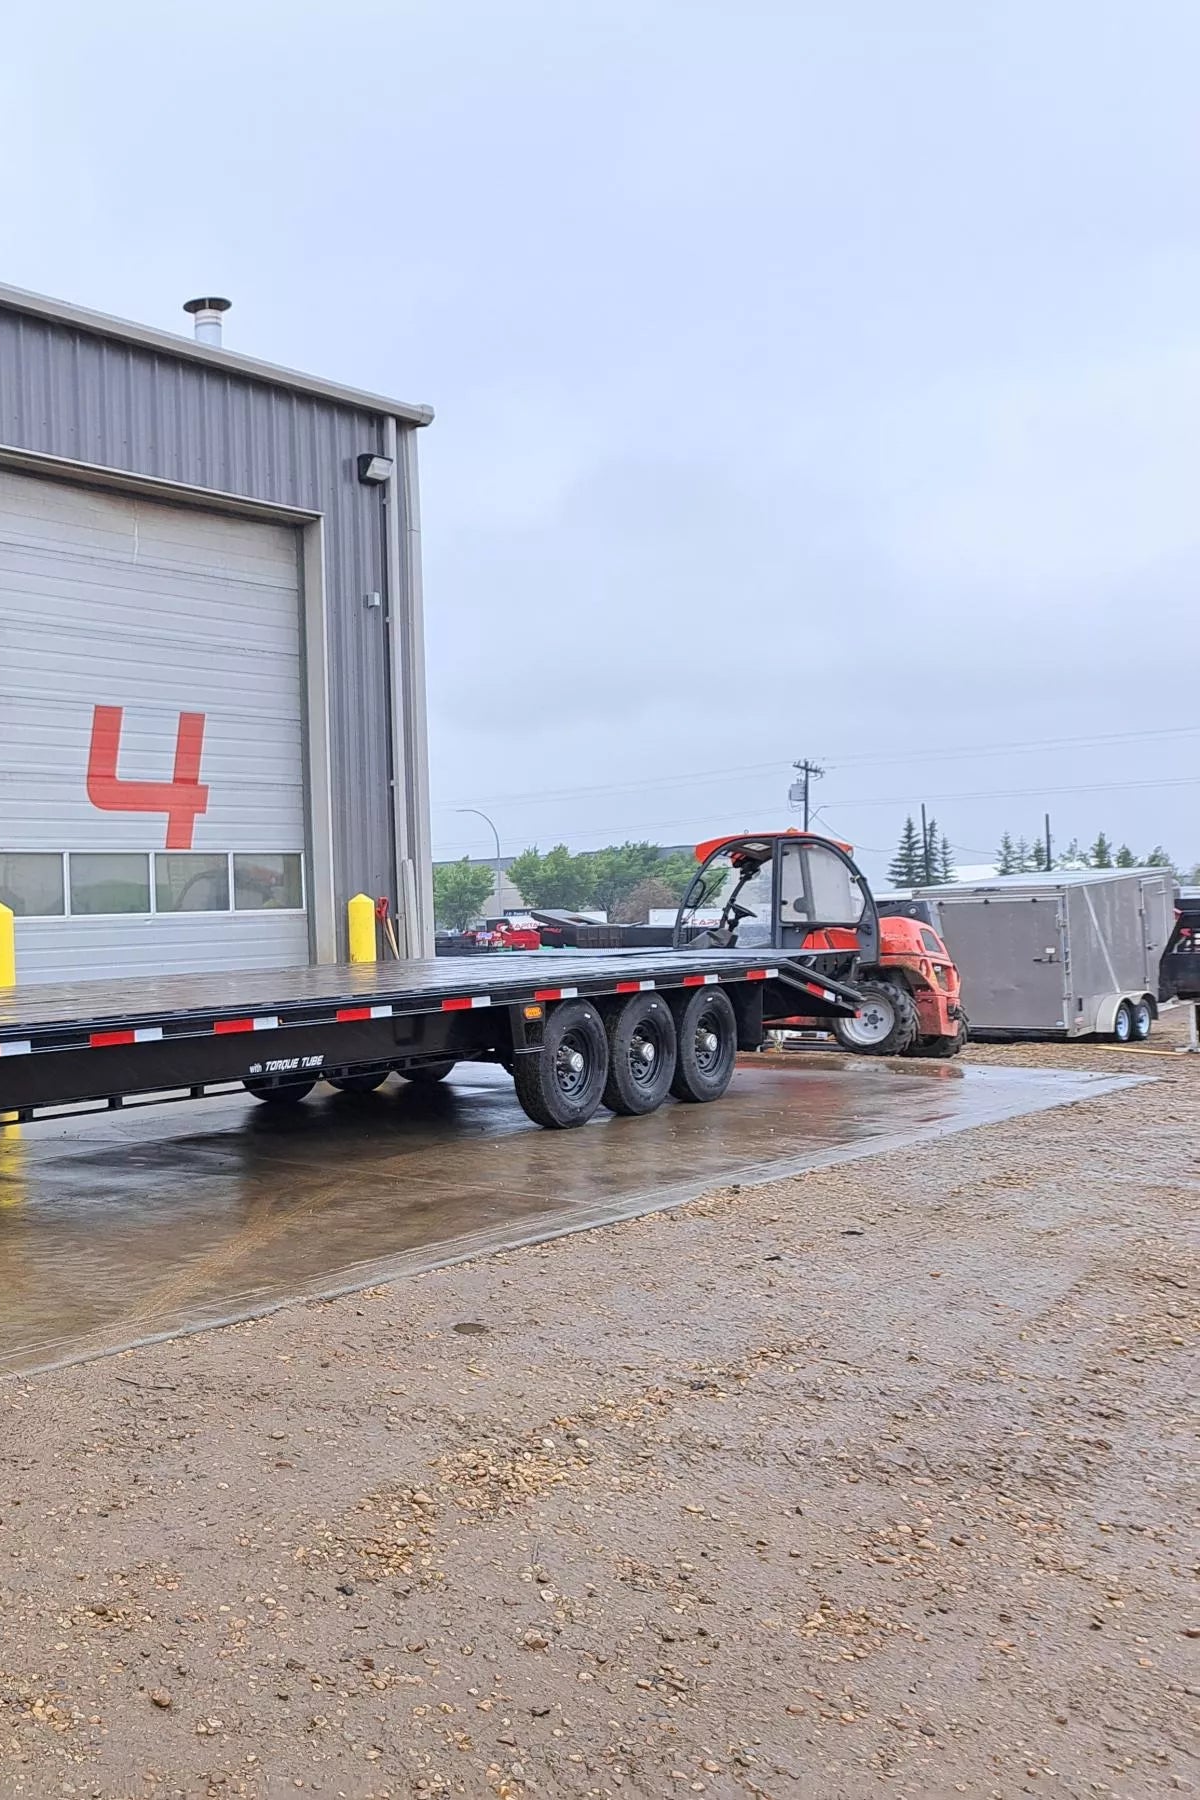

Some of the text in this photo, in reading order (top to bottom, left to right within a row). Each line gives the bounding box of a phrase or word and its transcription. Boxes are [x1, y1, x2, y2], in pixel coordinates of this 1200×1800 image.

[87, 704, 209, 850] 4
[249, 1055, 324, 1073] with TORQUE TUBE
